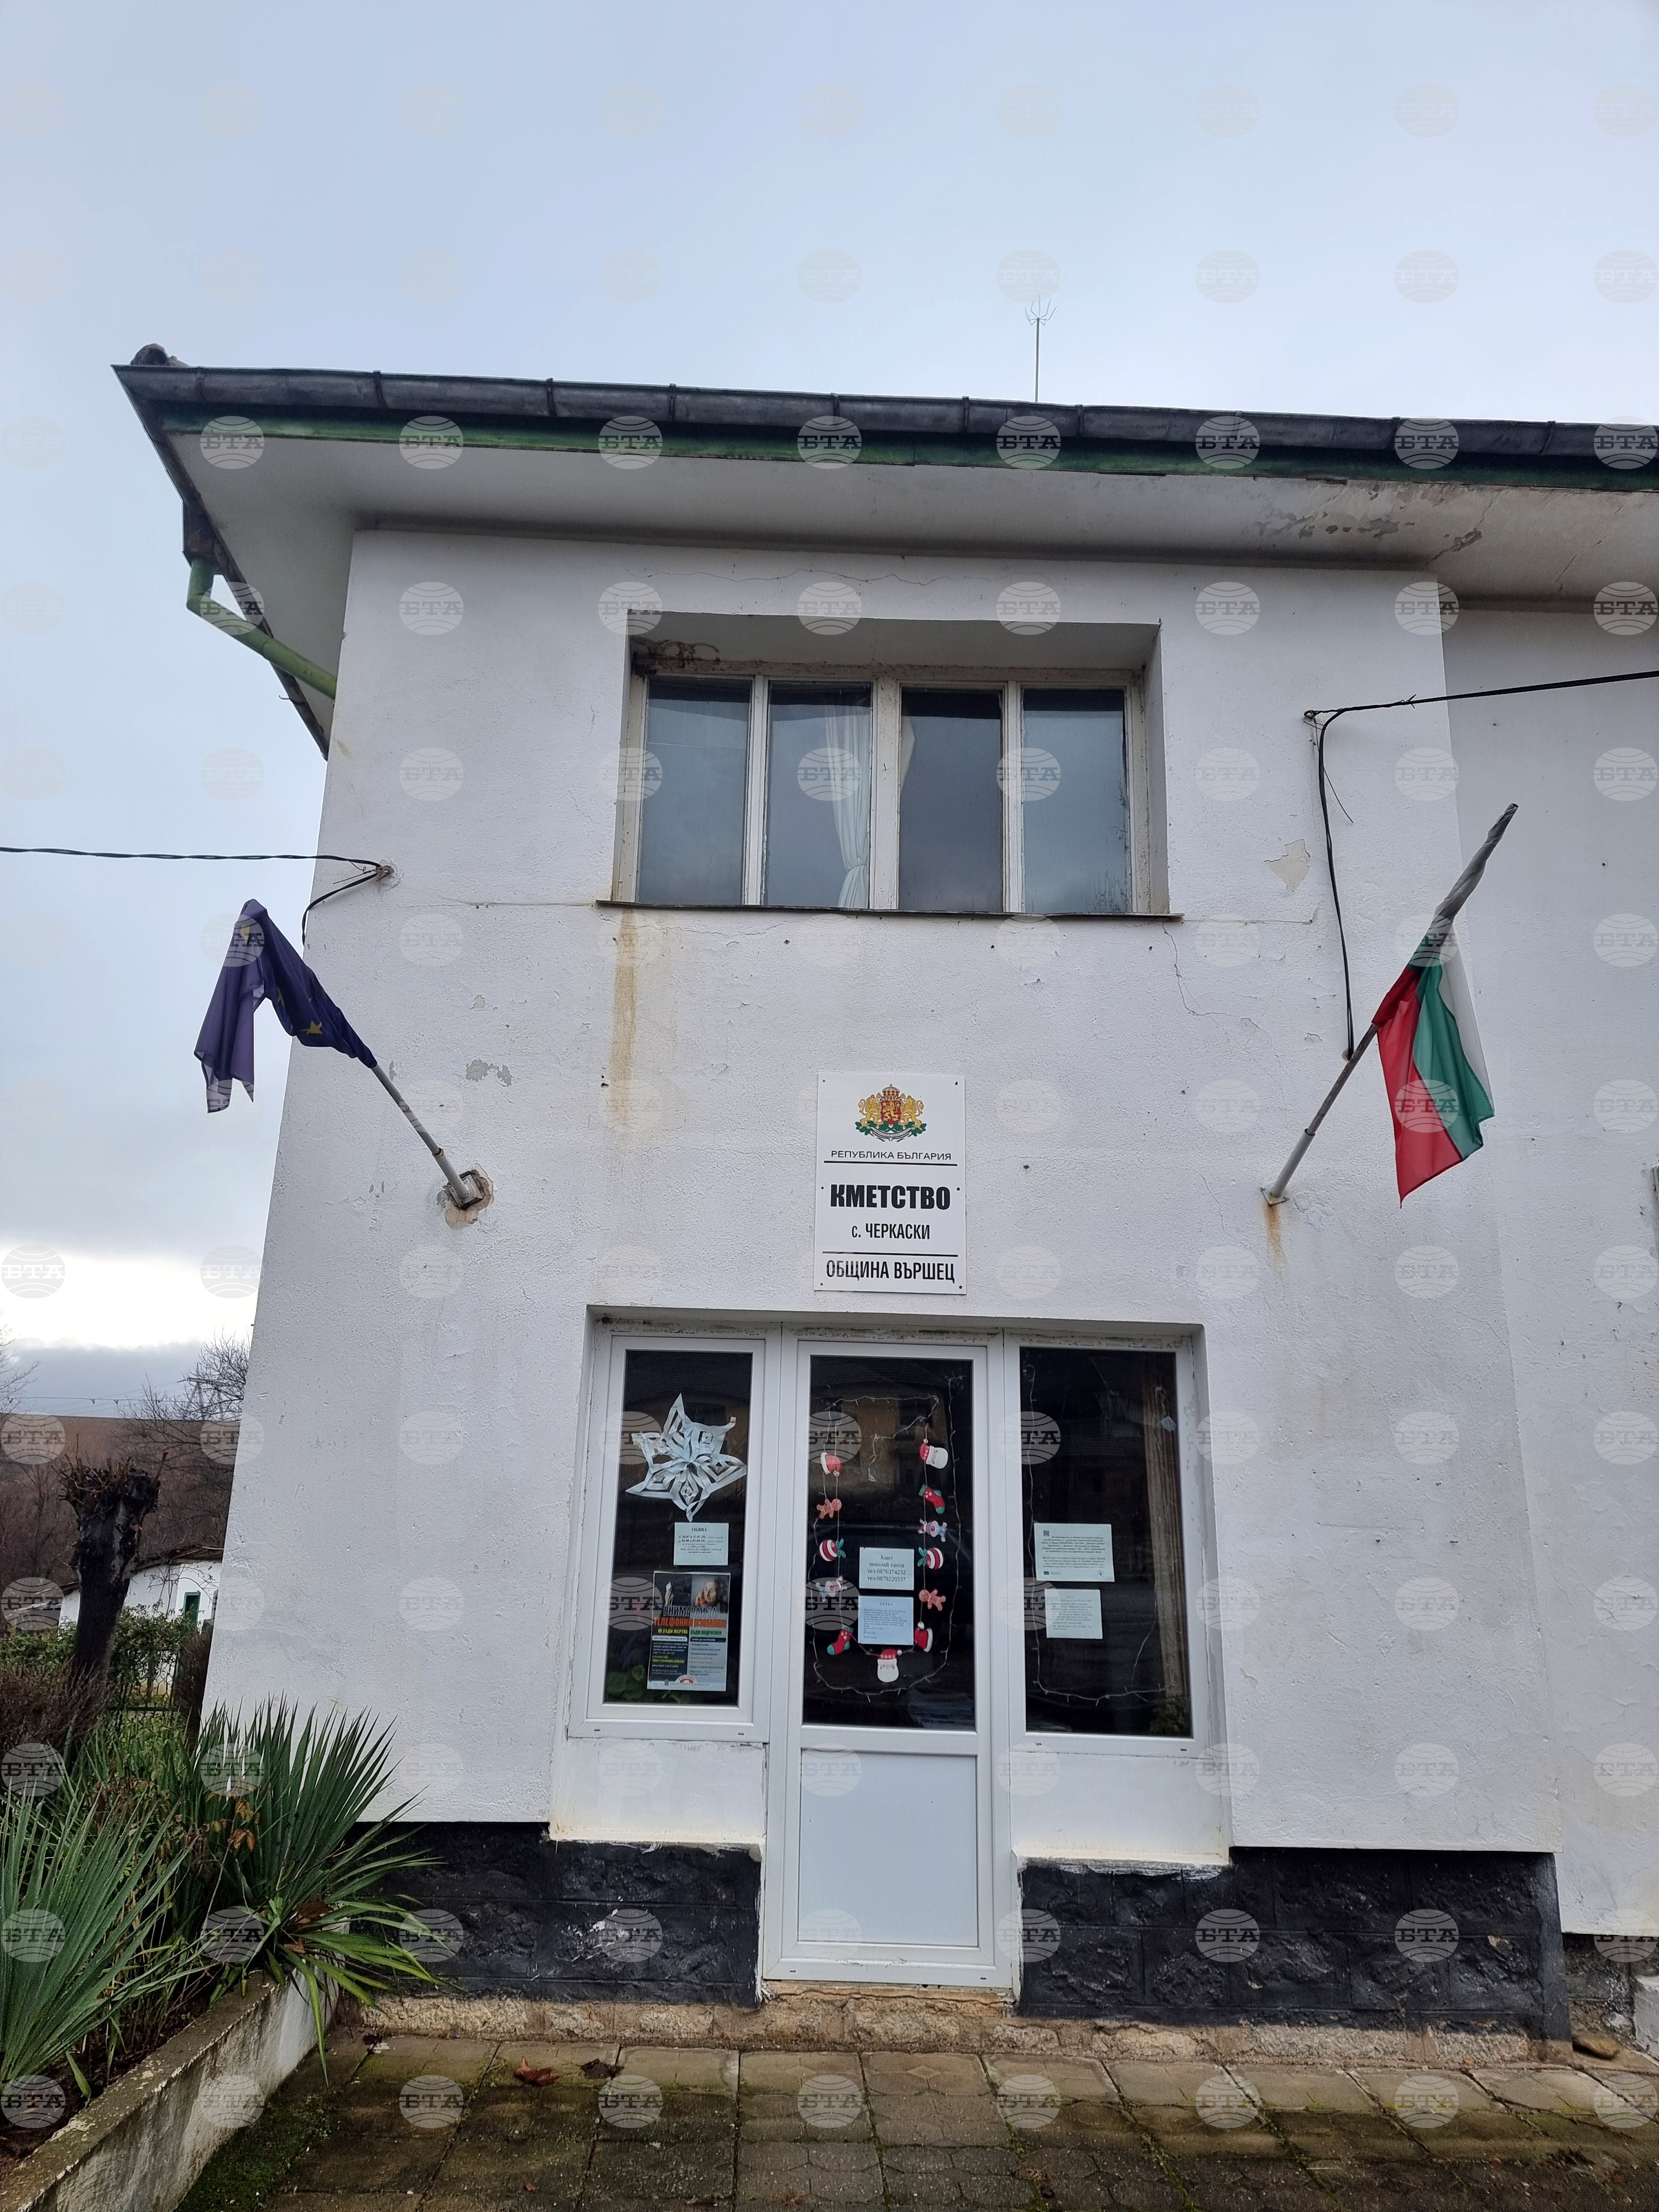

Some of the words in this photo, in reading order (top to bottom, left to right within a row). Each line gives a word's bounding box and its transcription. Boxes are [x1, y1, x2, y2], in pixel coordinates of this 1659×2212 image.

[831, 1150, 894, 1159] РЕПУБЛИКА
[897, 1152, 951, 1161] БЪЛГАРИЯ
[830, 1184, 951, 1210] КМЕТСТВО
[852, 1225, 861, 1238] с.
[865, 1223, 930, 1240] ЧЕРКАСКИ
[826, 1260, 889, 1281] ОБЩИНА
[894, 1261, 955, 1284] ВЪРШЕЦ
[664, 1605, 706, 1618] ВНИМАВАЙ
[654, 1616, 693, 1627] ТЕЛЕФОННИ
